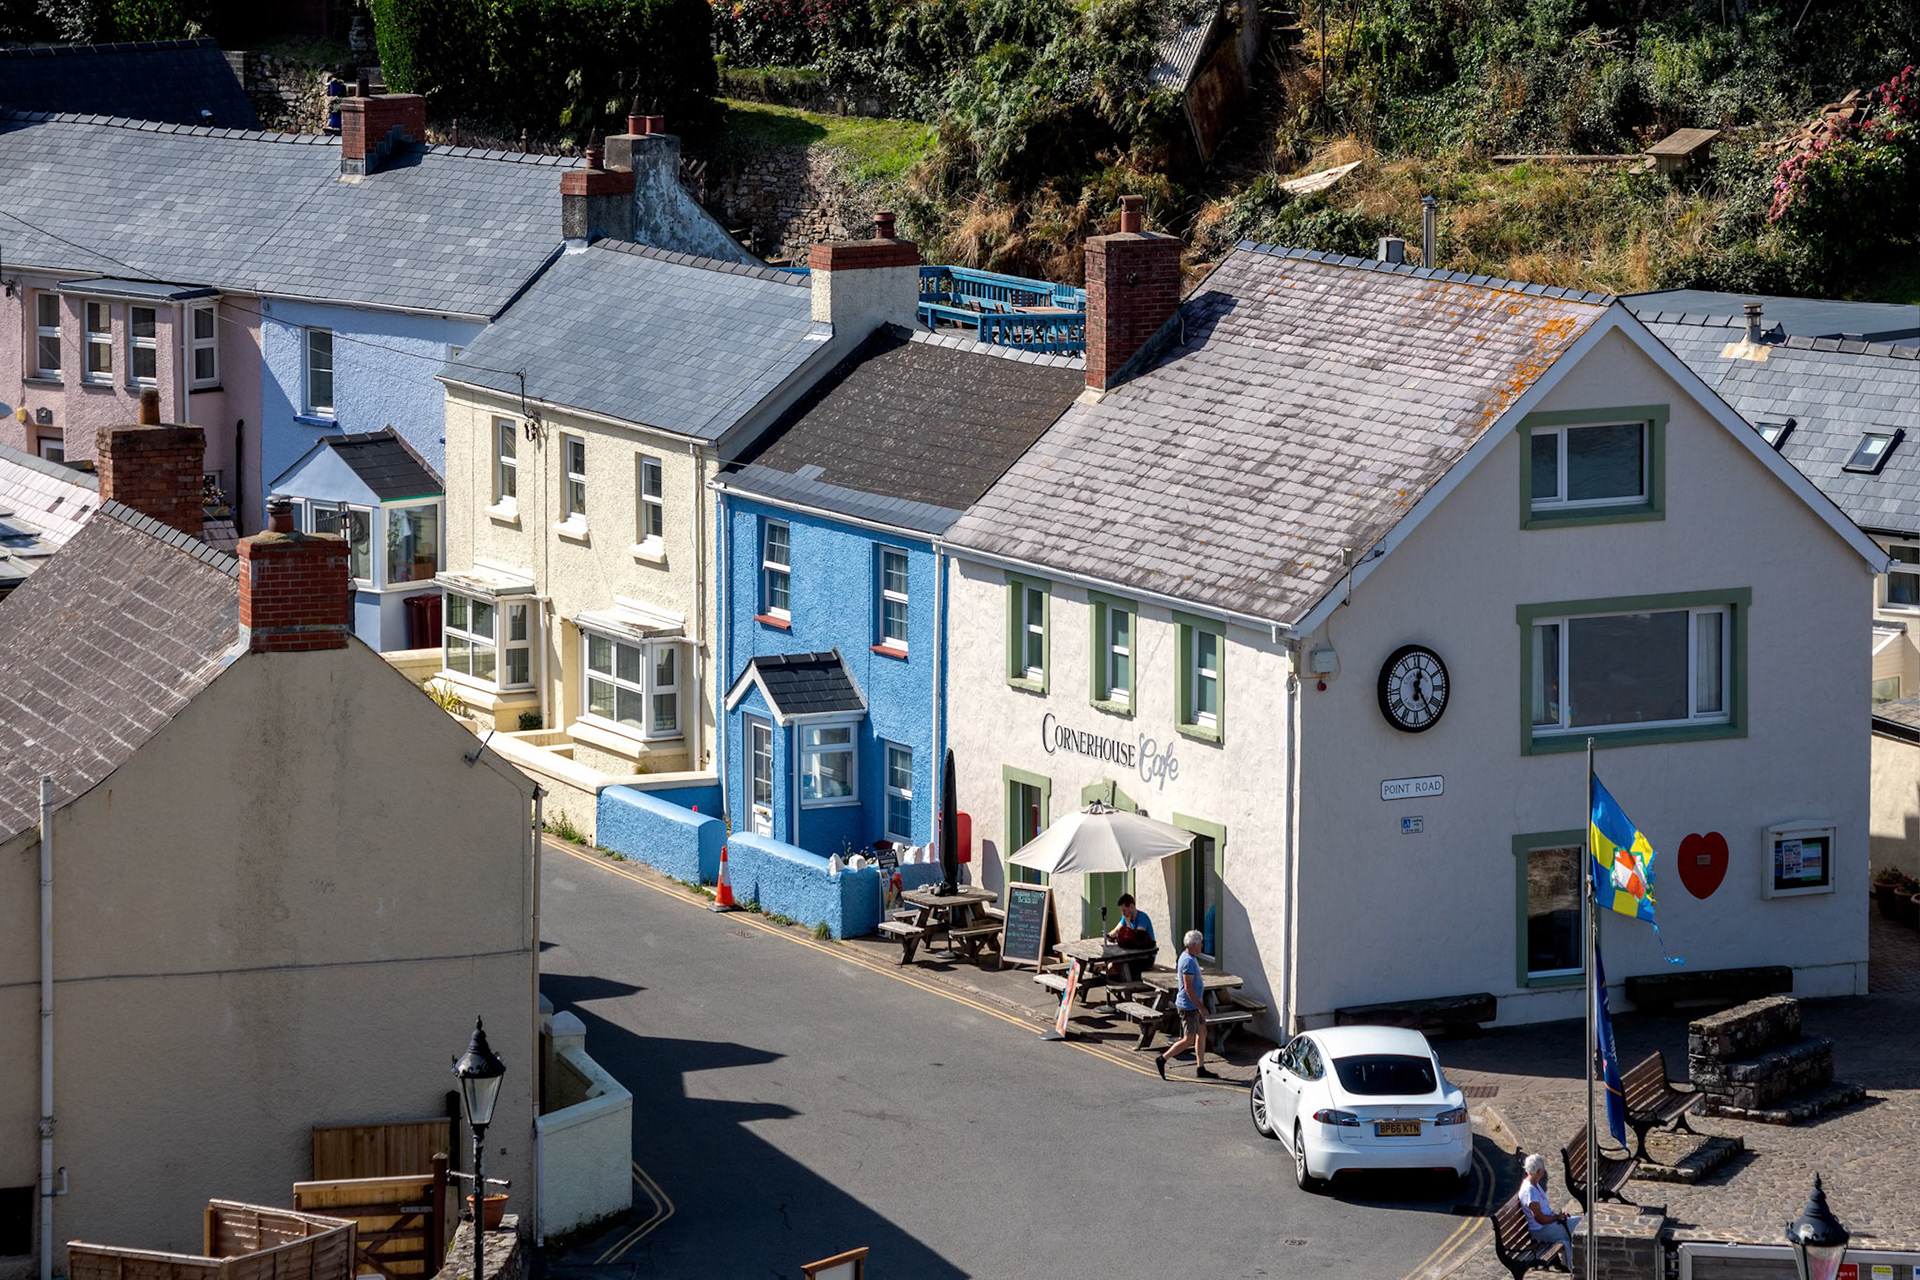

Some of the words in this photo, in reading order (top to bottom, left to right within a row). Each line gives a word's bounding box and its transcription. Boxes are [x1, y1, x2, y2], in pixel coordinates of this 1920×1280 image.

[1139, 732, 1179, 790] Cafe
[1384, 784, 1410, 795] POINT
[1415, 781, 1441, 792] ROAD
[1380, 1124, 1401, 1134] BP66
[1402, 1123, 1420, 1133] KTN
